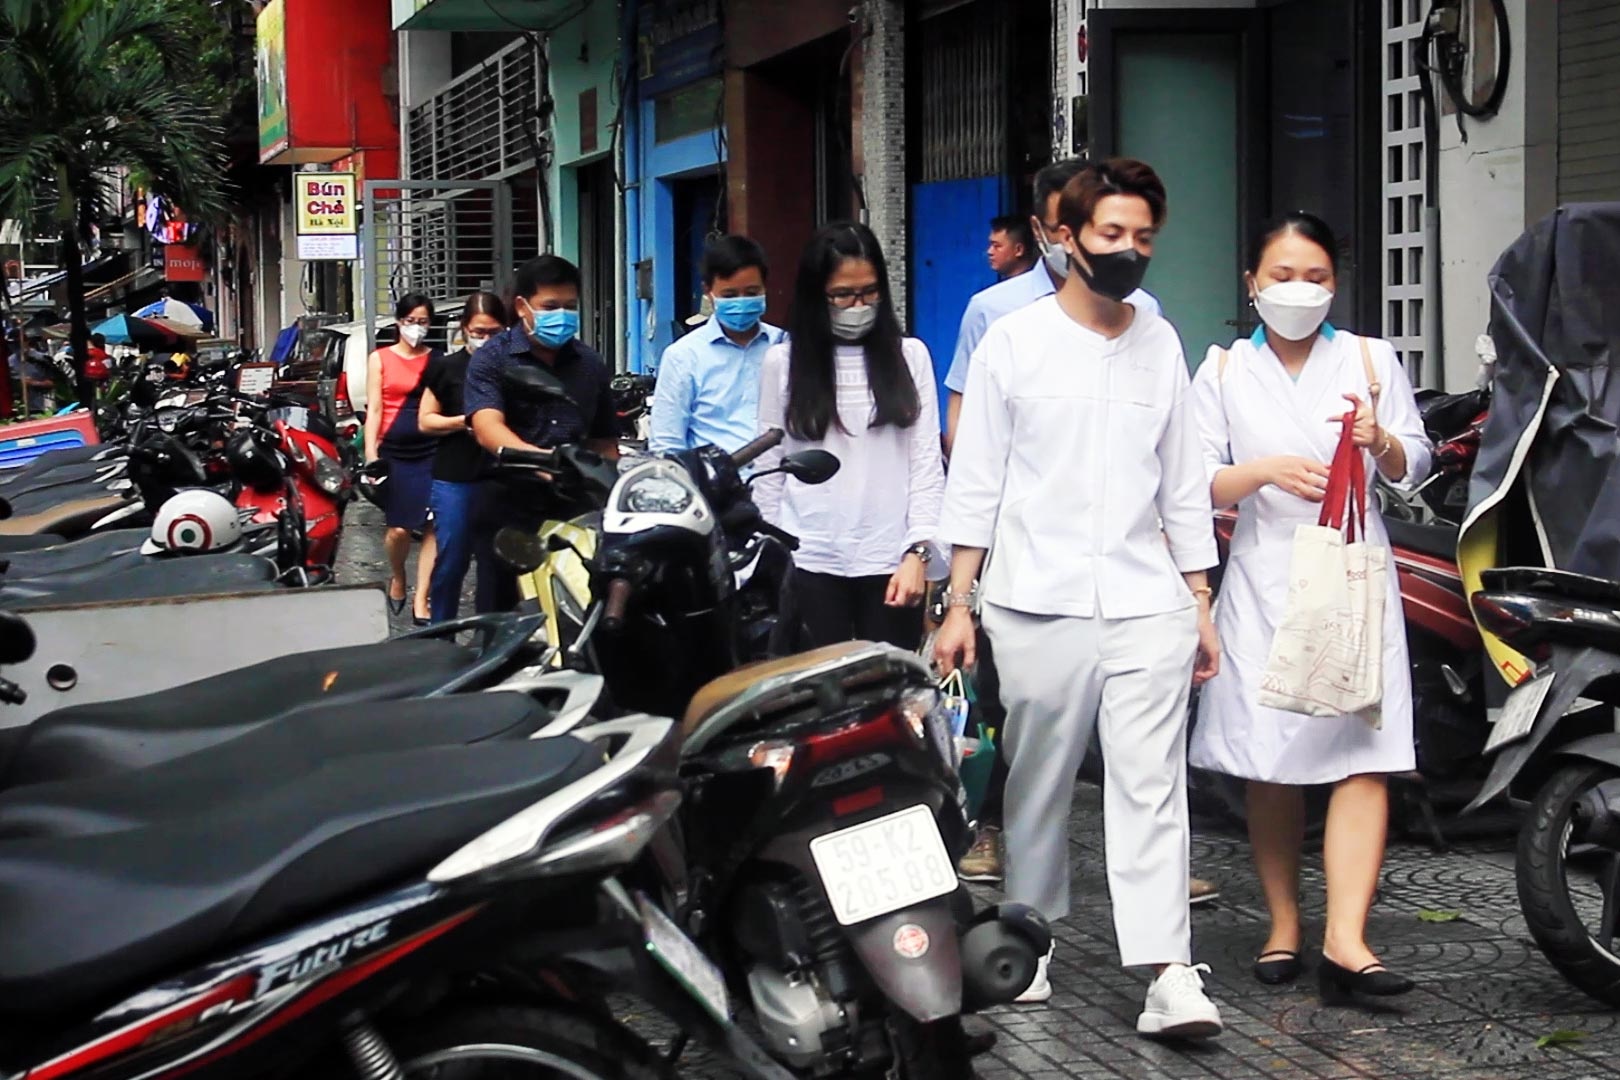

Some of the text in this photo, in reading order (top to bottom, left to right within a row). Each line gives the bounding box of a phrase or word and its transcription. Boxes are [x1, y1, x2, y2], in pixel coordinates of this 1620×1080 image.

[307, 181, 345, 196] Bún
[307, 199, 345, 215] Chả
[832, 819, 922, 873] 59-K2
